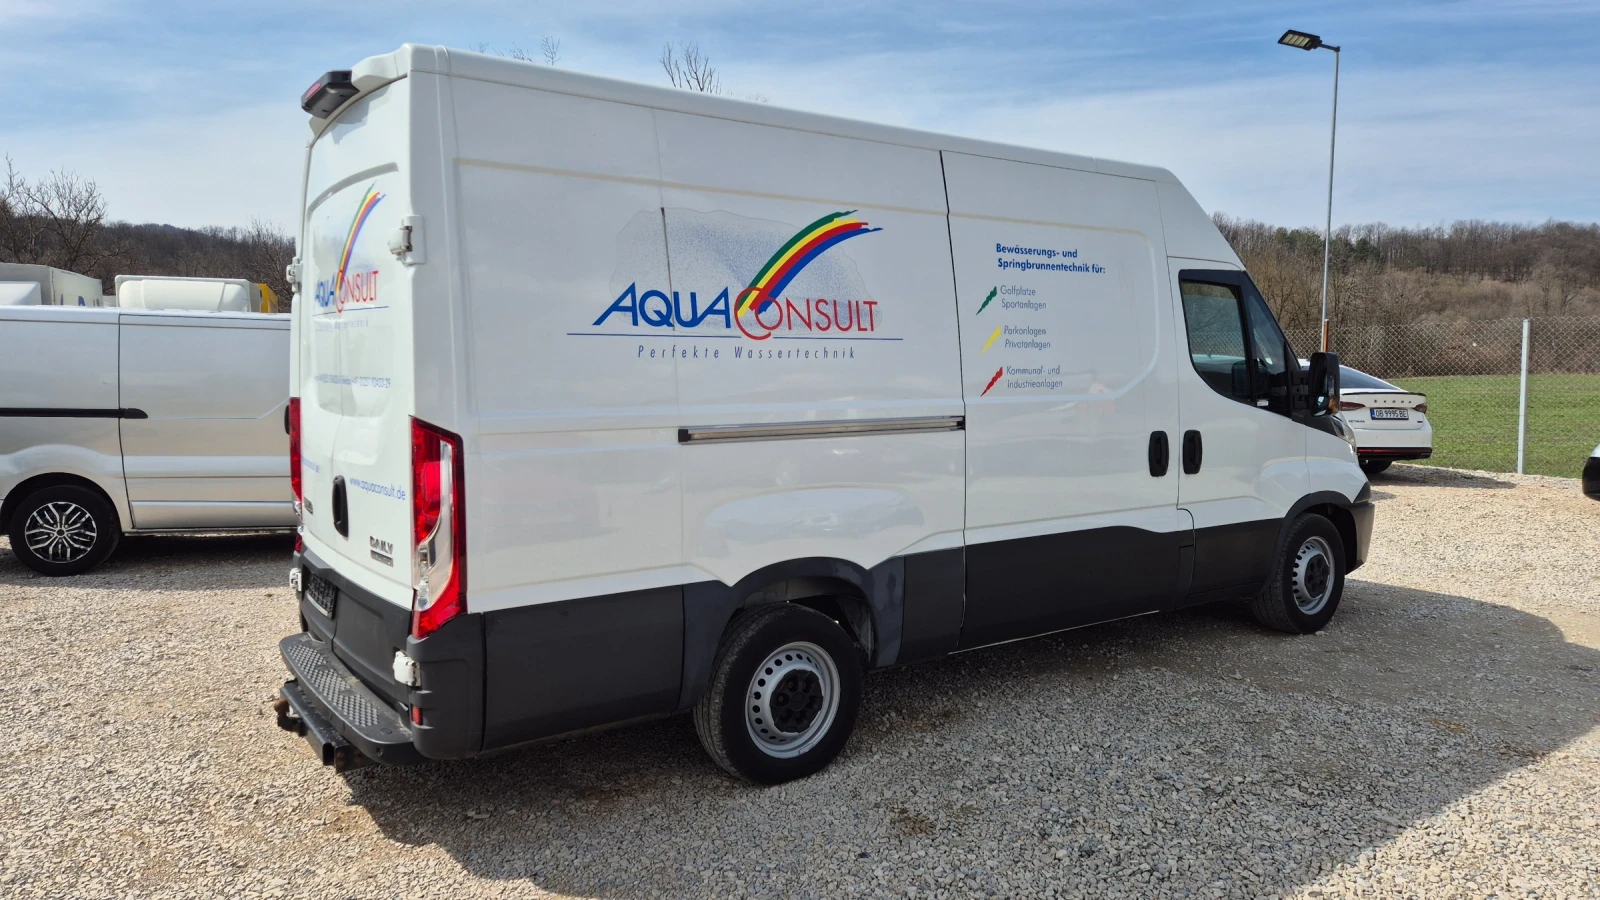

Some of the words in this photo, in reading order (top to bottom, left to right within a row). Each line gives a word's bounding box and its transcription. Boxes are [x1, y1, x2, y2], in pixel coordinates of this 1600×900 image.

[996, 243, 1060, 259] Bewässerungs-
[1062, 249, 1078, 258] und
[997, 257, 1090, 273] Springbrunnentechnik
[1091, 263, 1106, 274] für:
[1001, 298, 1047, 311] Sportanlagen
[1003, 325, 1047, 338] Parkanlagen
[1004, 338, 1051, 350] Privatanlagen
[637, 344, 720, 359] Perfekte
[734, 346, 855, 360] Wassertechnik
[1006, 365, 1045, 376] Kommunal-
[1047, 364, 1060, 375] und
[1007, 378, 1063, 390] Industrieanlagen
[1399, 409, 1407, 418] BE
[349, 477, 407, 501] www.aquaconsult.de
